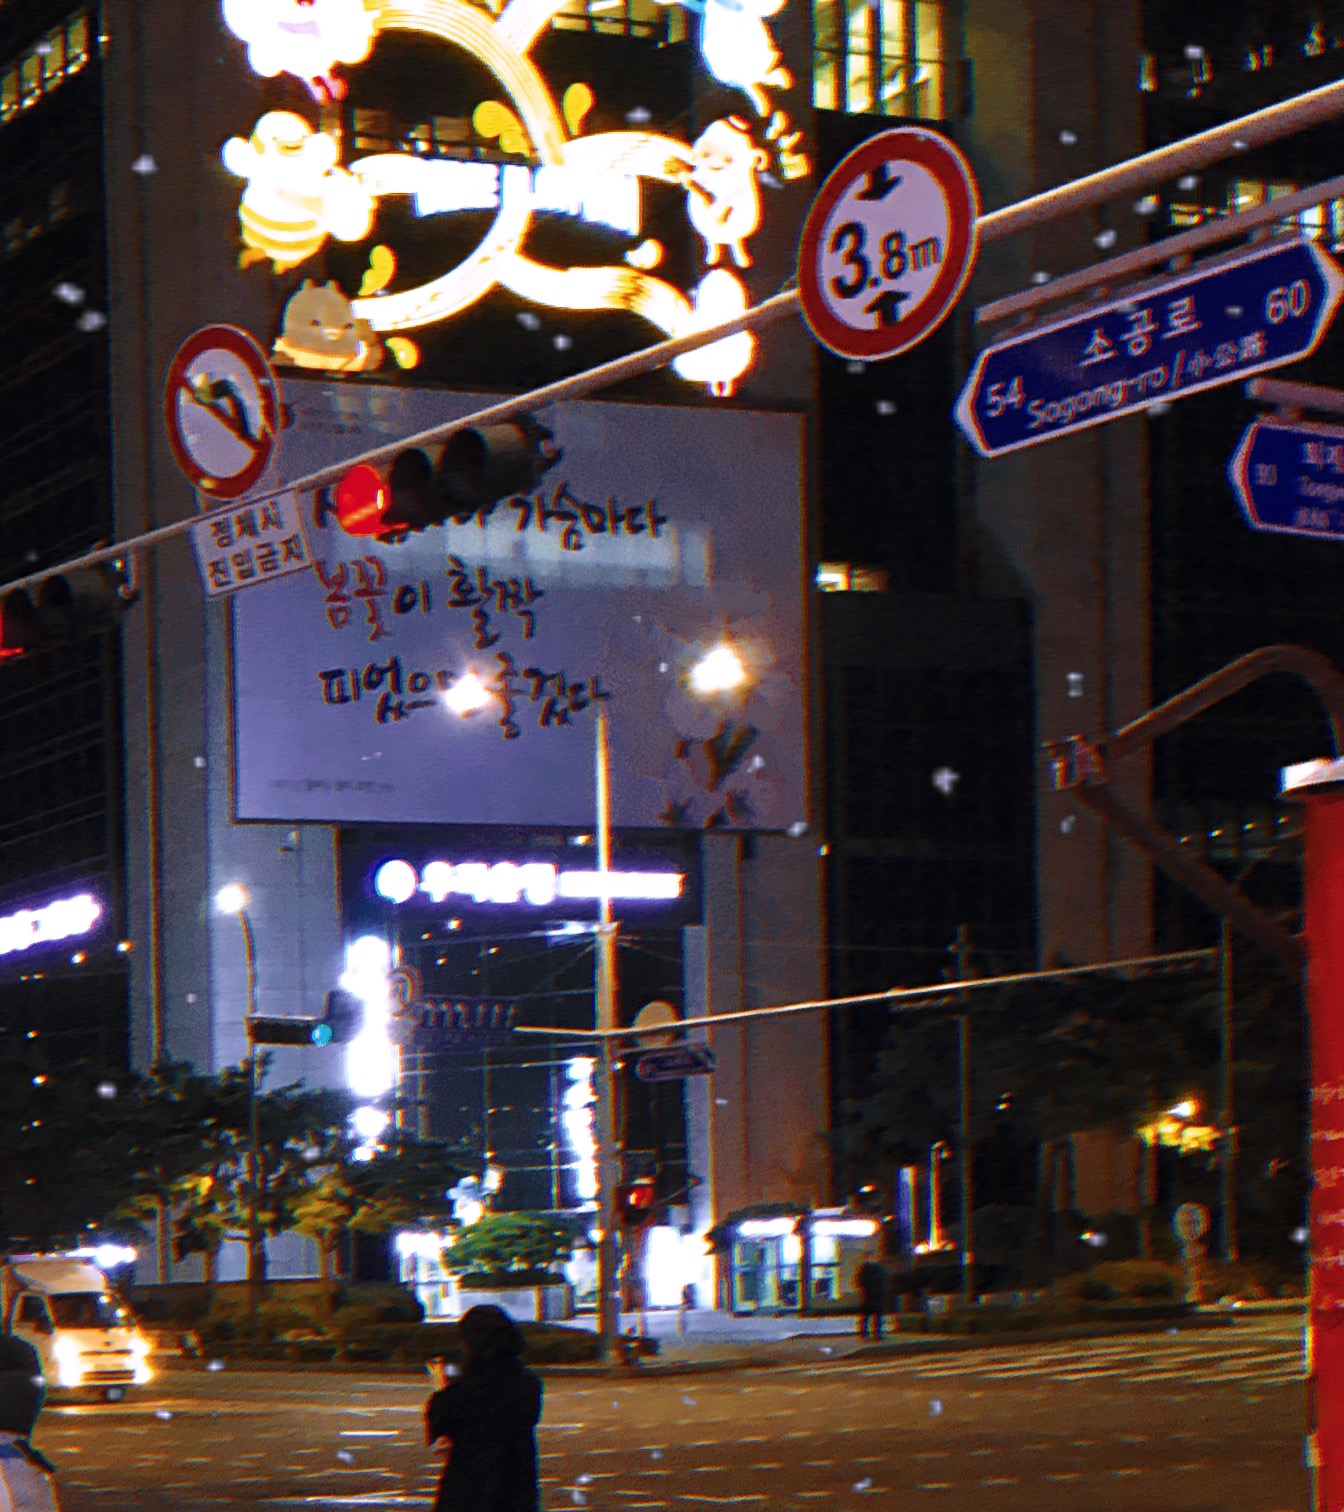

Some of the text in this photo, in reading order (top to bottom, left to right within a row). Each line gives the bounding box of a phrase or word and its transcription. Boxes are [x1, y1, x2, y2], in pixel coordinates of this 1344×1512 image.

[828, 220, 943, 299] 3.8m
[1078, 296, 1203, 369] 소공로
[1264, 279, 1311, 325] 60
[984, 376, 1028, 418] 54
[208, 500, 285, 549] 정체시
[508, 481, 668, 552] 가슴마다
[206, 533, 306, 588] 진입금지
[313, 554, 545, 651] 봄꽃이 활짝
